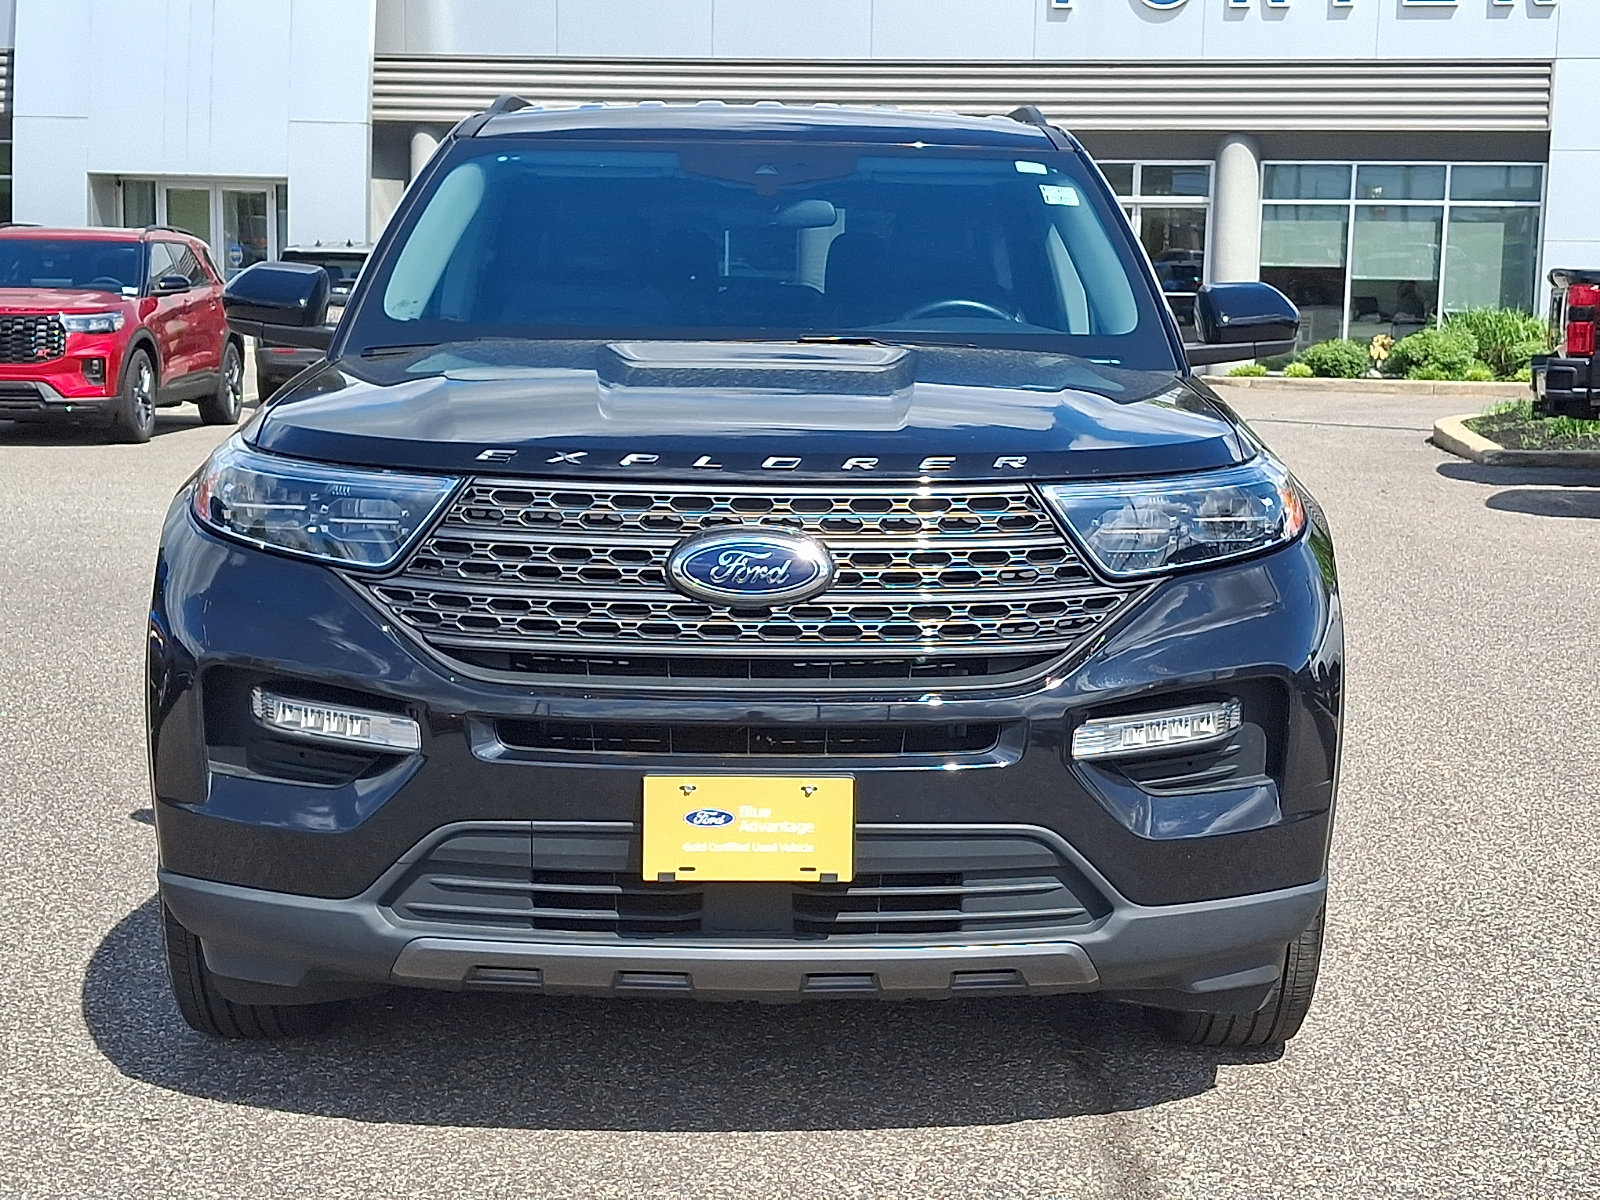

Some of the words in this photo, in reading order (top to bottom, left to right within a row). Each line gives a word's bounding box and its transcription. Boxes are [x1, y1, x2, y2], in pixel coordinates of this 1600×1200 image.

[475, 449, 1028, 470] EXPLORER
[710, 550, 792, 584] Ford
[738, 805, 771, 818] Blue
[738, 819, 815, 835] Advantage
[682, 842, 707, 852] Gold
[709, 842, 750, 852] Certified
[752, 842, 778, 852] Used
[780, 842, 814, 852] Vehicle
